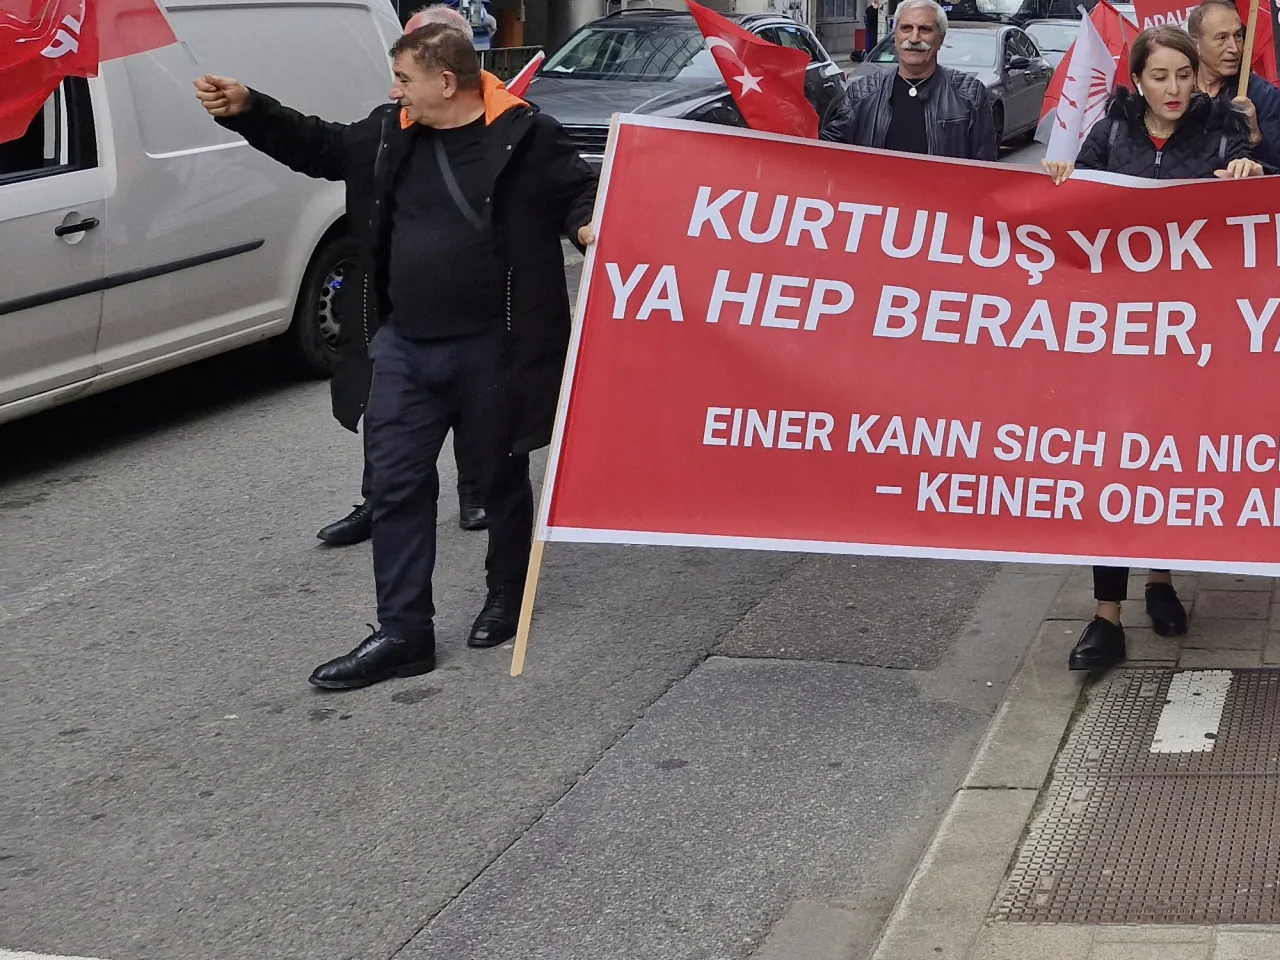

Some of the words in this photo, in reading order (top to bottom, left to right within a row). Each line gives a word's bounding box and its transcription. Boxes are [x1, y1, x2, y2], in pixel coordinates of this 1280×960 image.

[686, 185, 1056, 286] KURTULUŞ
[1067, 219, 1213, 274] YOK
[604, 262, 684, 322] YA
[705, 269, 855, 331] HEP
[872, 284, 1212, 368] BERABER,
[702, 406, 835, 451] EINER
[847, 413, 982, 459] KANN
[993, 423, 1107, 467] SICH
[1119, 432, 1183, 473] DA
[916, 471, 1085, 520] KEINER
[1098, 482, 1224, 527] ODER
